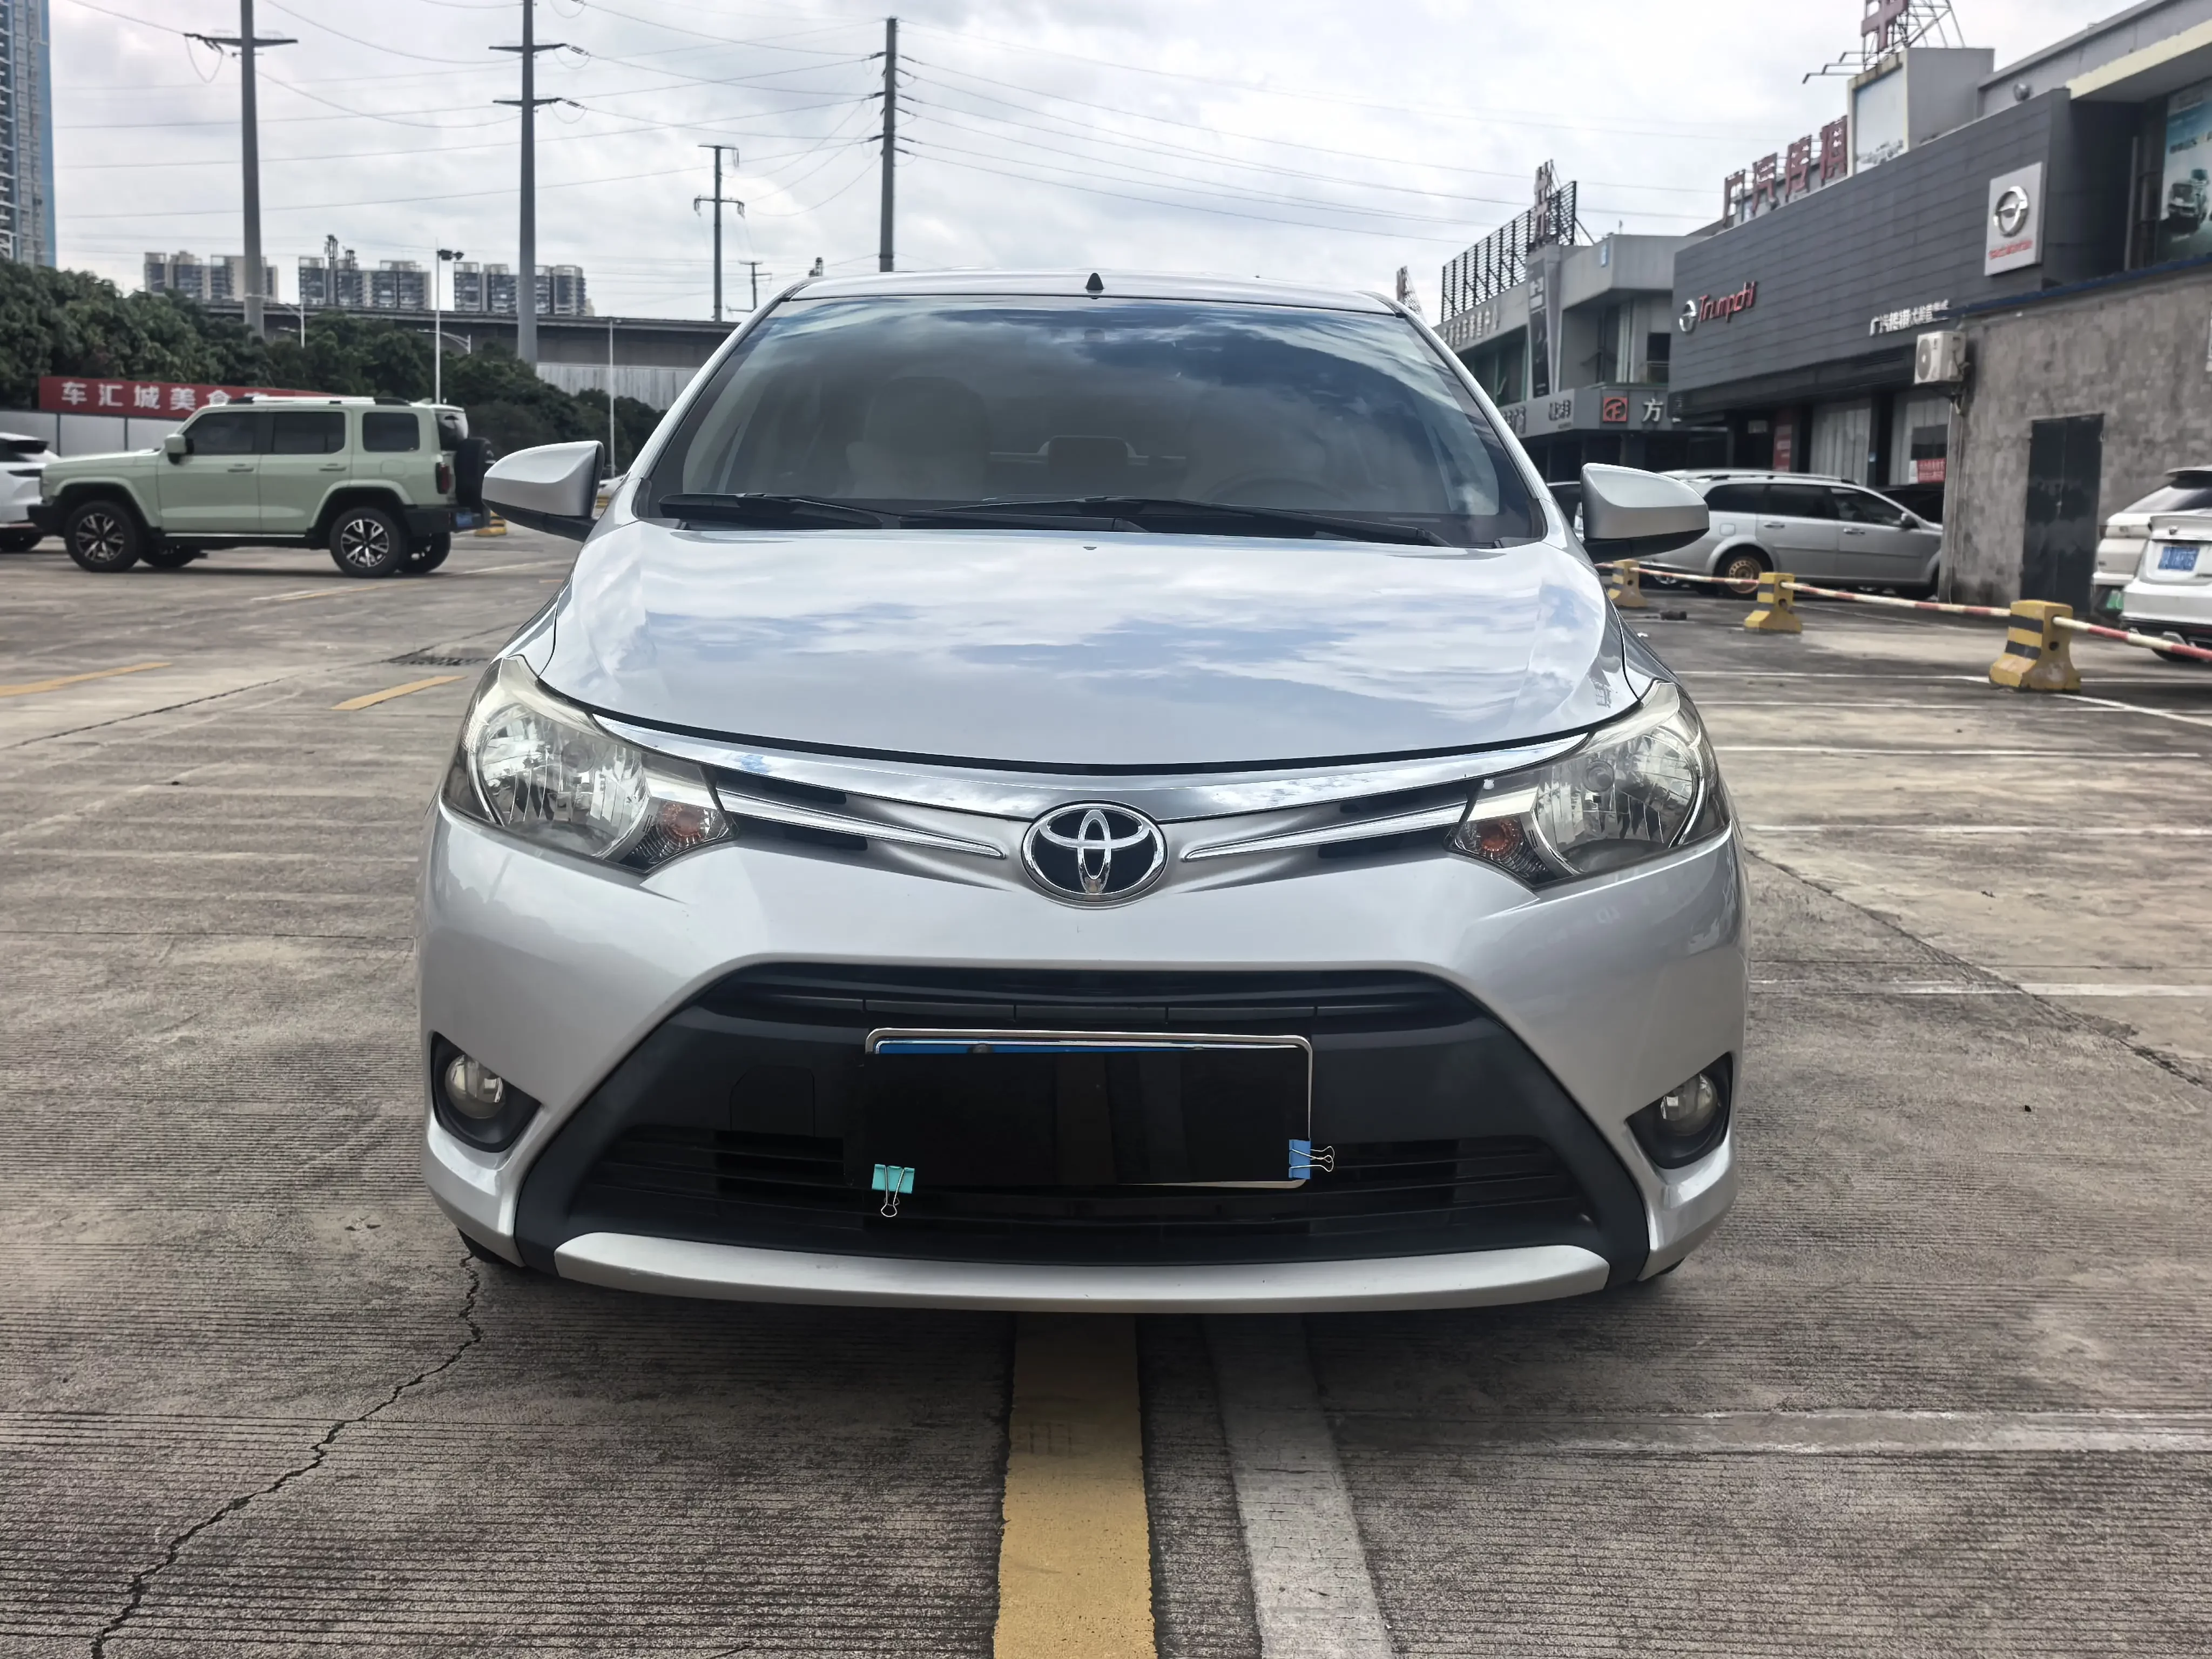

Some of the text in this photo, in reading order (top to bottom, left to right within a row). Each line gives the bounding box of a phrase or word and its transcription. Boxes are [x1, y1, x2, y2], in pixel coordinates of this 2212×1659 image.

[61, 381, 268, 412] 车汇城美食
